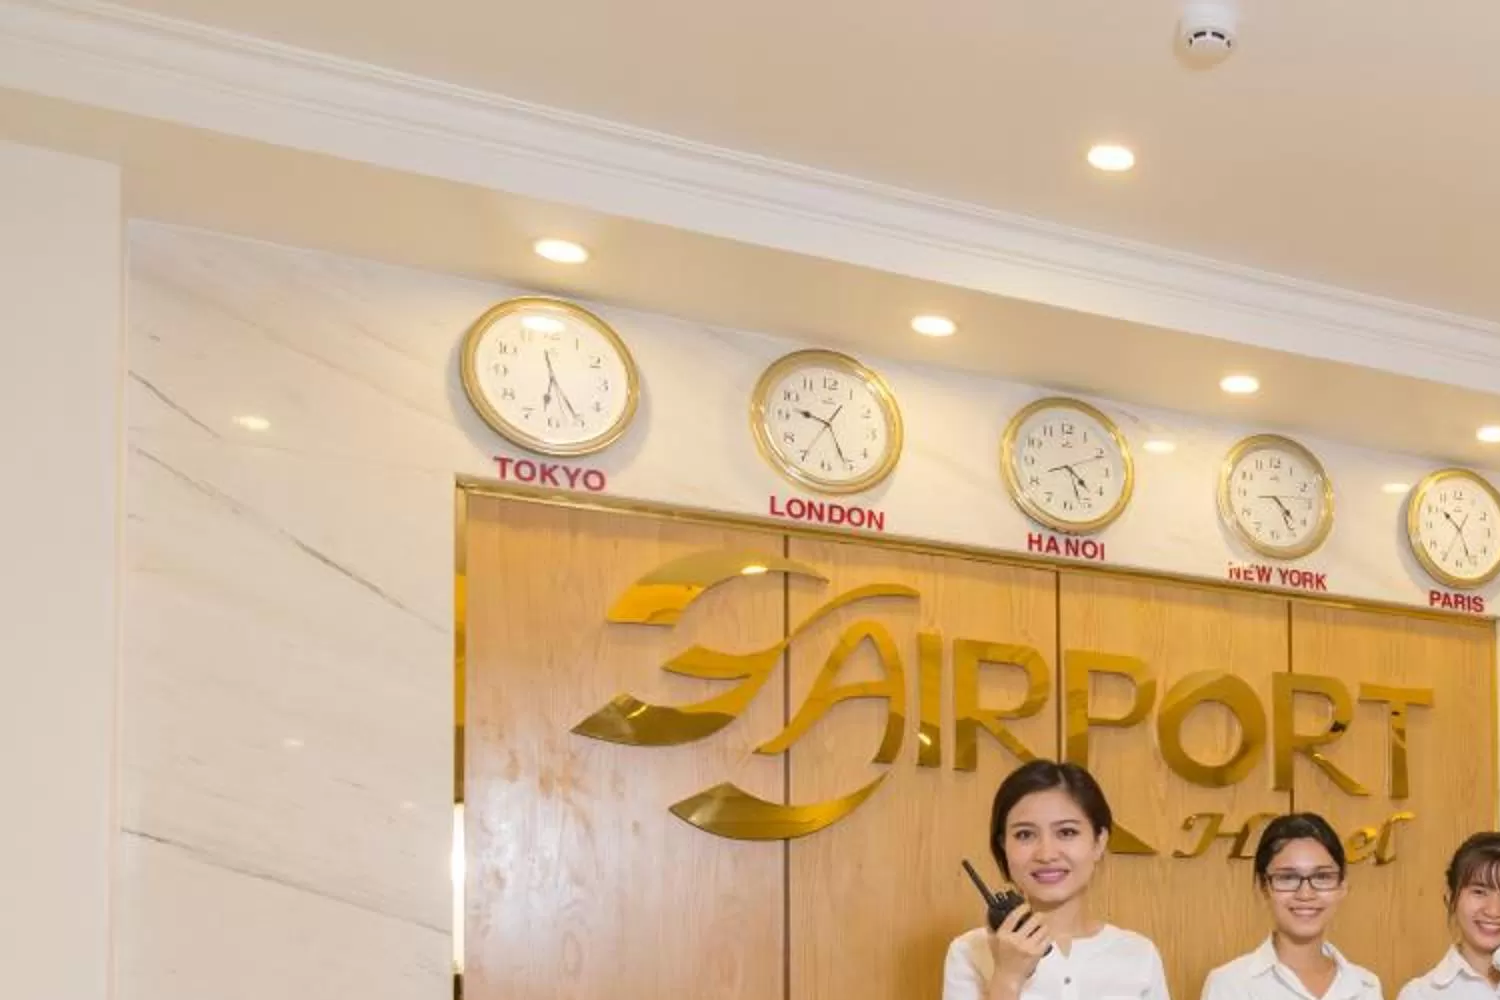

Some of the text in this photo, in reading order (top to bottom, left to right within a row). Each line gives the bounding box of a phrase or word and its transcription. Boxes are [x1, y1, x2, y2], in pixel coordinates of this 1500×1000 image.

[803, 377, 814, 392] 11
[822, 376, 839, 391] 12
[493, 456, 606, 491] TOKYO
[770, 496, 884, 530] LONDON
[1228, 562, 1328, 591] NEW YORK
[1429, 590, 1484, 613] PARIS
[753, 620, 1433, 856] AIRPORT
[1172, 811, 1416, 866] Hel
